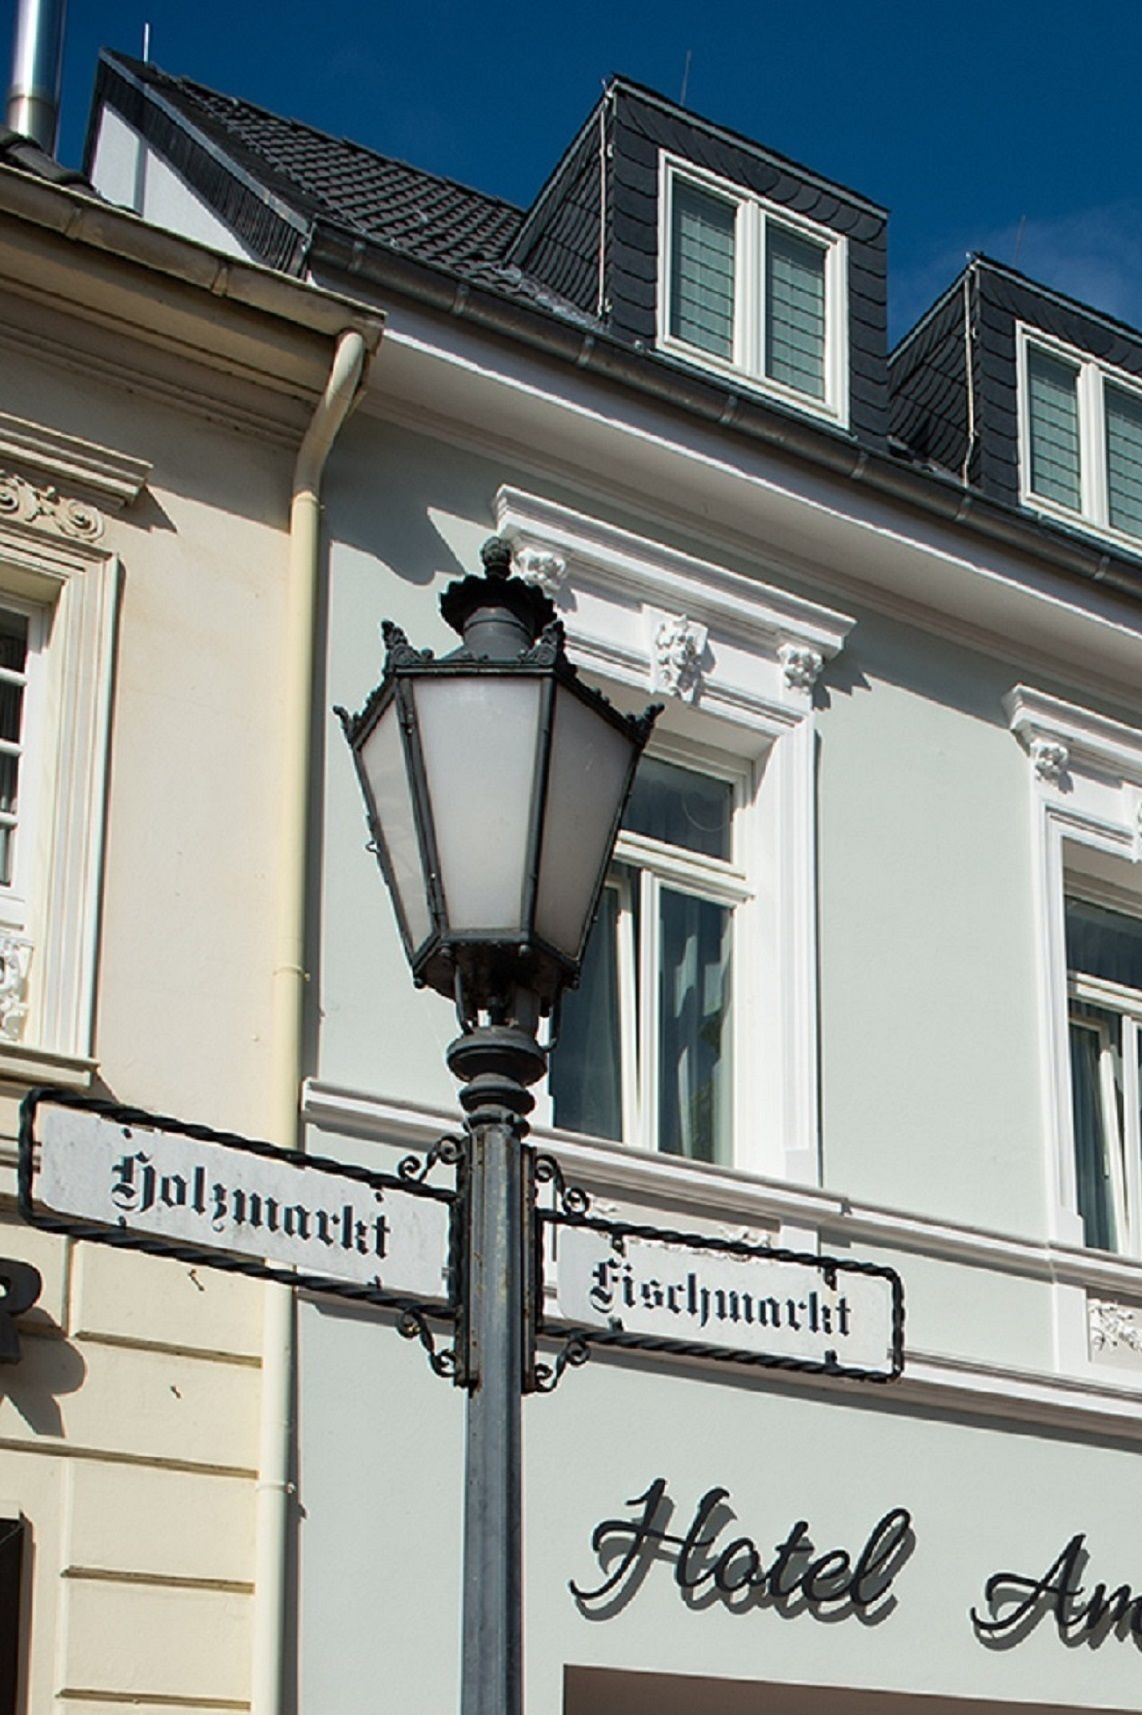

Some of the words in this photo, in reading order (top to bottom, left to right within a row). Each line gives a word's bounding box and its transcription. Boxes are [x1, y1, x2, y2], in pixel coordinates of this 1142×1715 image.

[110, 1150, 391, 1260] Holzmarkt
[589, 1257, 851, 1338] Fischmarkt
[569, 1478, 911, 1608] Hotel
